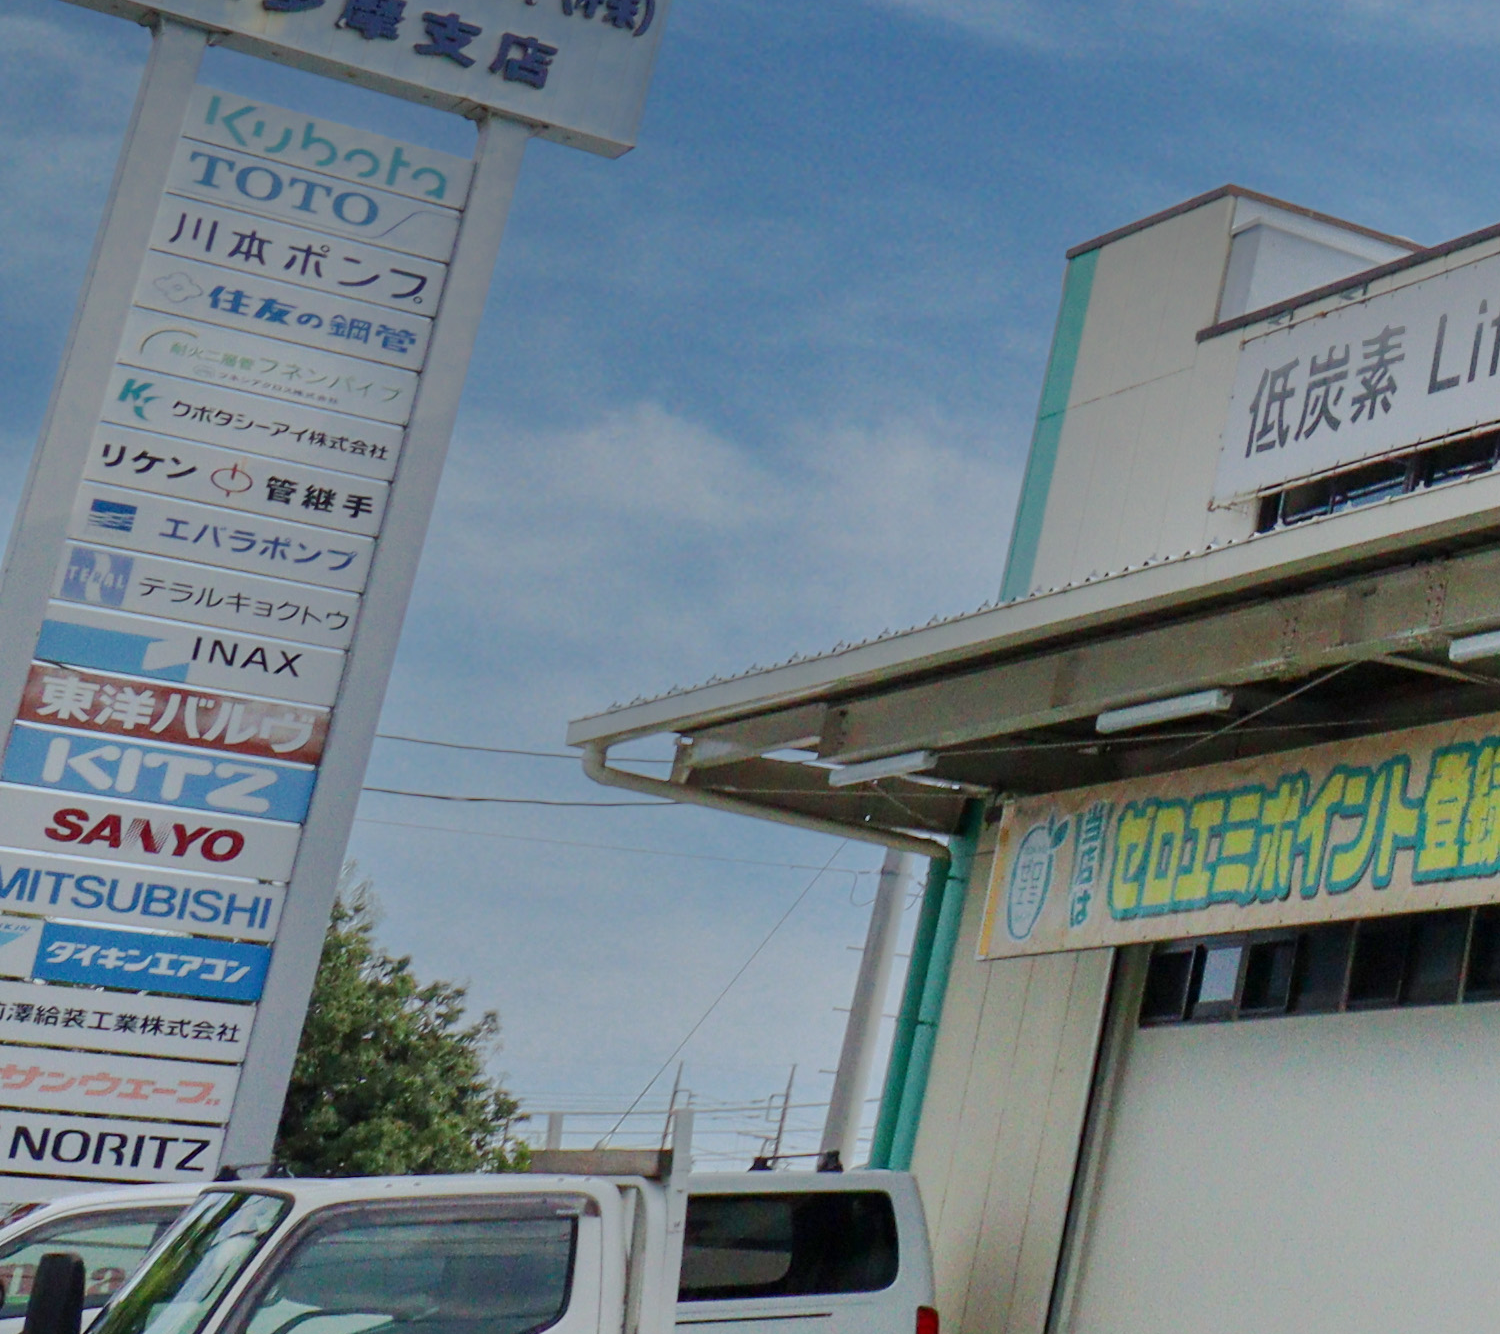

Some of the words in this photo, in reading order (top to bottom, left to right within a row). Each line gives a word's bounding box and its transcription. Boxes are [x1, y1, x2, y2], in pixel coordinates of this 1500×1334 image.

[205, 94, 449, 200] Kubota
[189, 151, 380, 227] TOTO
[169, 212, 430, 305] 川本ポンプ
[208, 284, 417, 355] 住友の鋼管
[1244, 323, 1406, 459] 低炭素
[172, 400, 389, 461] クボタシーアイ株式会社
[102, 443, 198, 480] リケン
[266, 475, 373, 518] 管継手
[158, 517, 358, 571] エバラポンプ
[68, 565, 126, 590] TERAL
[139, 577, 350, 631] テラルキョクトウ
[191, 636, 304, 677] INAX
[36, 674, 317, 754] 東洋バルヴ
[42, 737, 279, 815] KITZ
[44, 808, 244, 862] SANYO
[0, 867, 273, 929] MITSUBISHI
[46, 941, 251, 983] ダイキンエアコン
[0, 1001, 241, 1043] 澤給装工業株式会社
[8, 1126, 211, 1172] NORITZ
